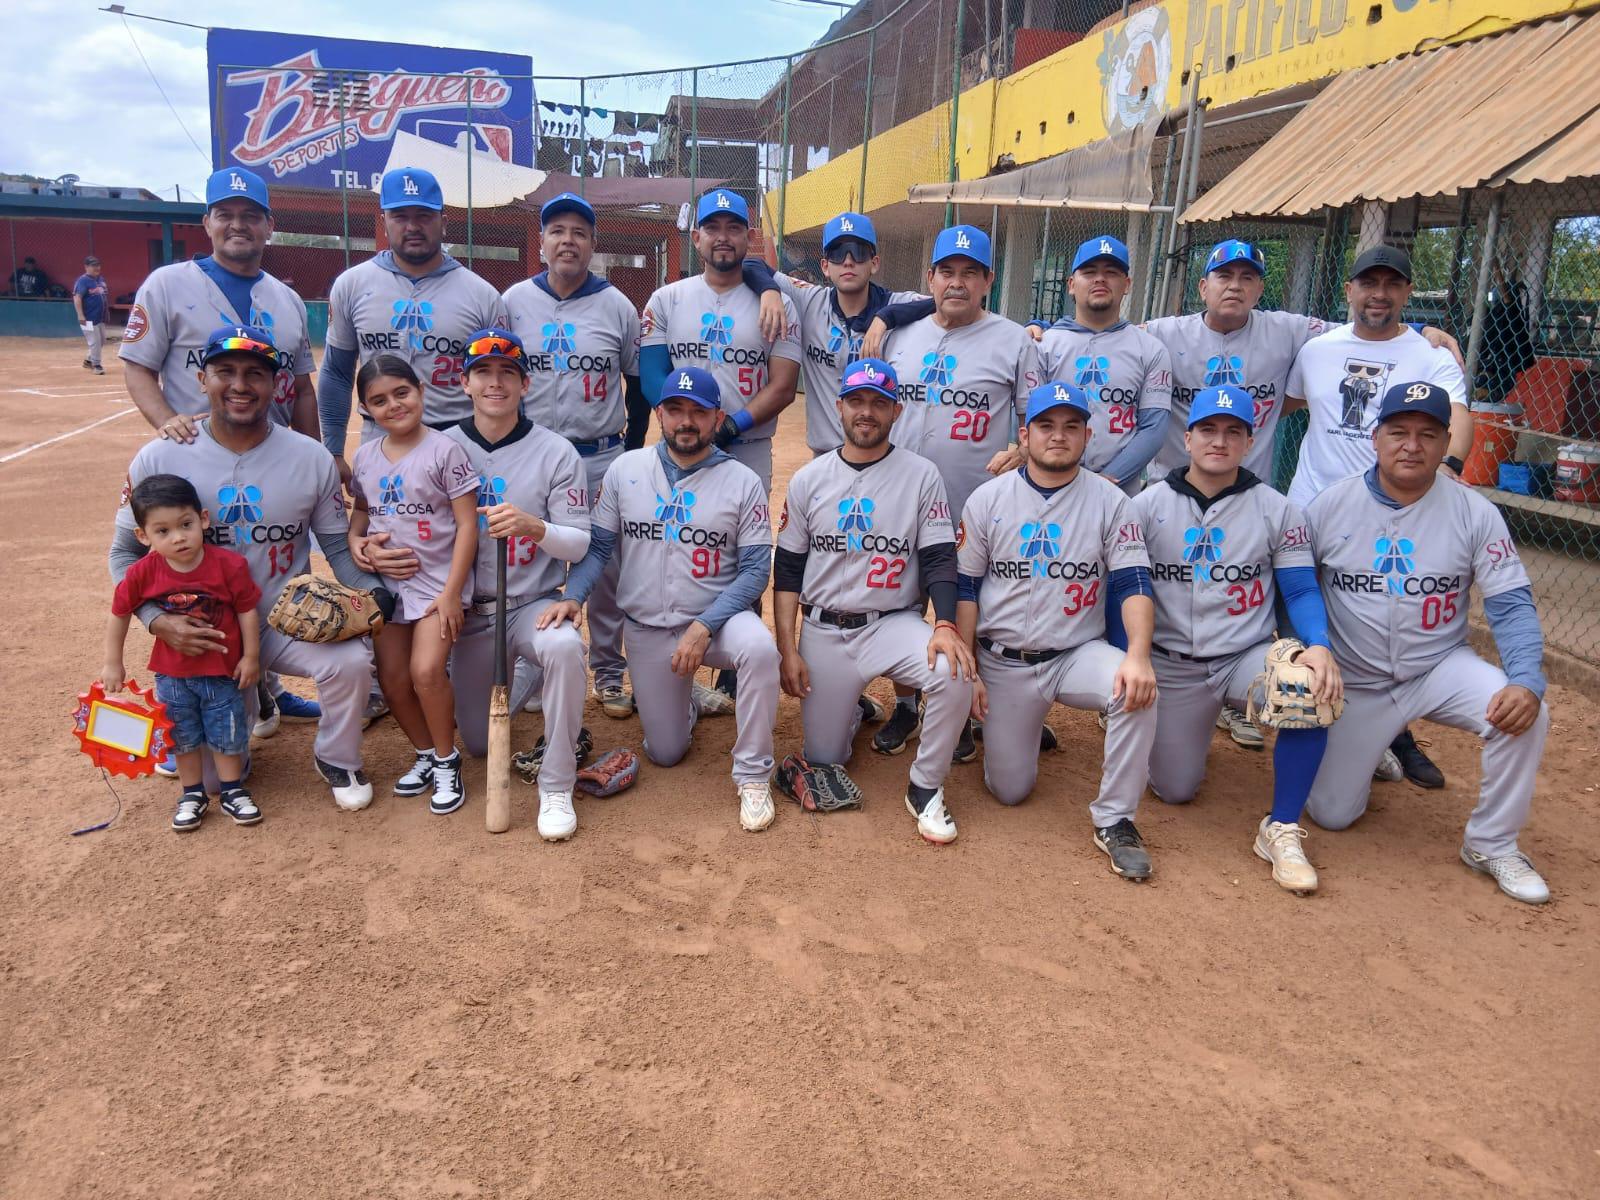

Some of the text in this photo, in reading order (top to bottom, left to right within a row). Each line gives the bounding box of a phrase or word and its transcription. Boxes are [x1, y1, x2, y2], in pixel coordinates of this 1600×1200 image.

[270, 128, 358, 174] DEPORTES
[230, 173, 247, 192] LA
[330, 169, 367, 189] TEL.
[403, 176, 419, 195] LA
[717, 193, 731, 208] LA
[840, 217, 853, 232] LA
[956, 231, 970, 249] LA
[1099, 240, 1112, 254] LA
[524, 354, 612, 373] RRENCOSA
[669, 342, 767, 365] ARRENCOSA
[431, 357, 464, 386] 25
[678, 372, 693, 390] LA
[583, 373, 607, 403] 14
[896, 383, 991, 411] RRENCOSA
[1054, 385, 1070, 401] LA
[1216, 390, 1232, 408] LA
[950, 410, 991, 442] 20
[1109, 405, 1136, 434] 24
[417, 520, 432, 541] 5
[624, 521, 728, 548] ARRENCOSA
[507, 535, 537, 567] 13
[811, 533, 910, 555] ARRENCOSA
[267, 543, 295, 578] 13
[691, 548, 720, 579] 91
[866, 556, 906, 589] 22
[990, 560, 1100, 580] ARRENCOSA
[1331, 572, 1461, 597] ARRENCOSA
[1063, 580, 1100, 616] 34
[1227, 580, 1265, 616] 34
[1421, 592, 1458, 630] 05
